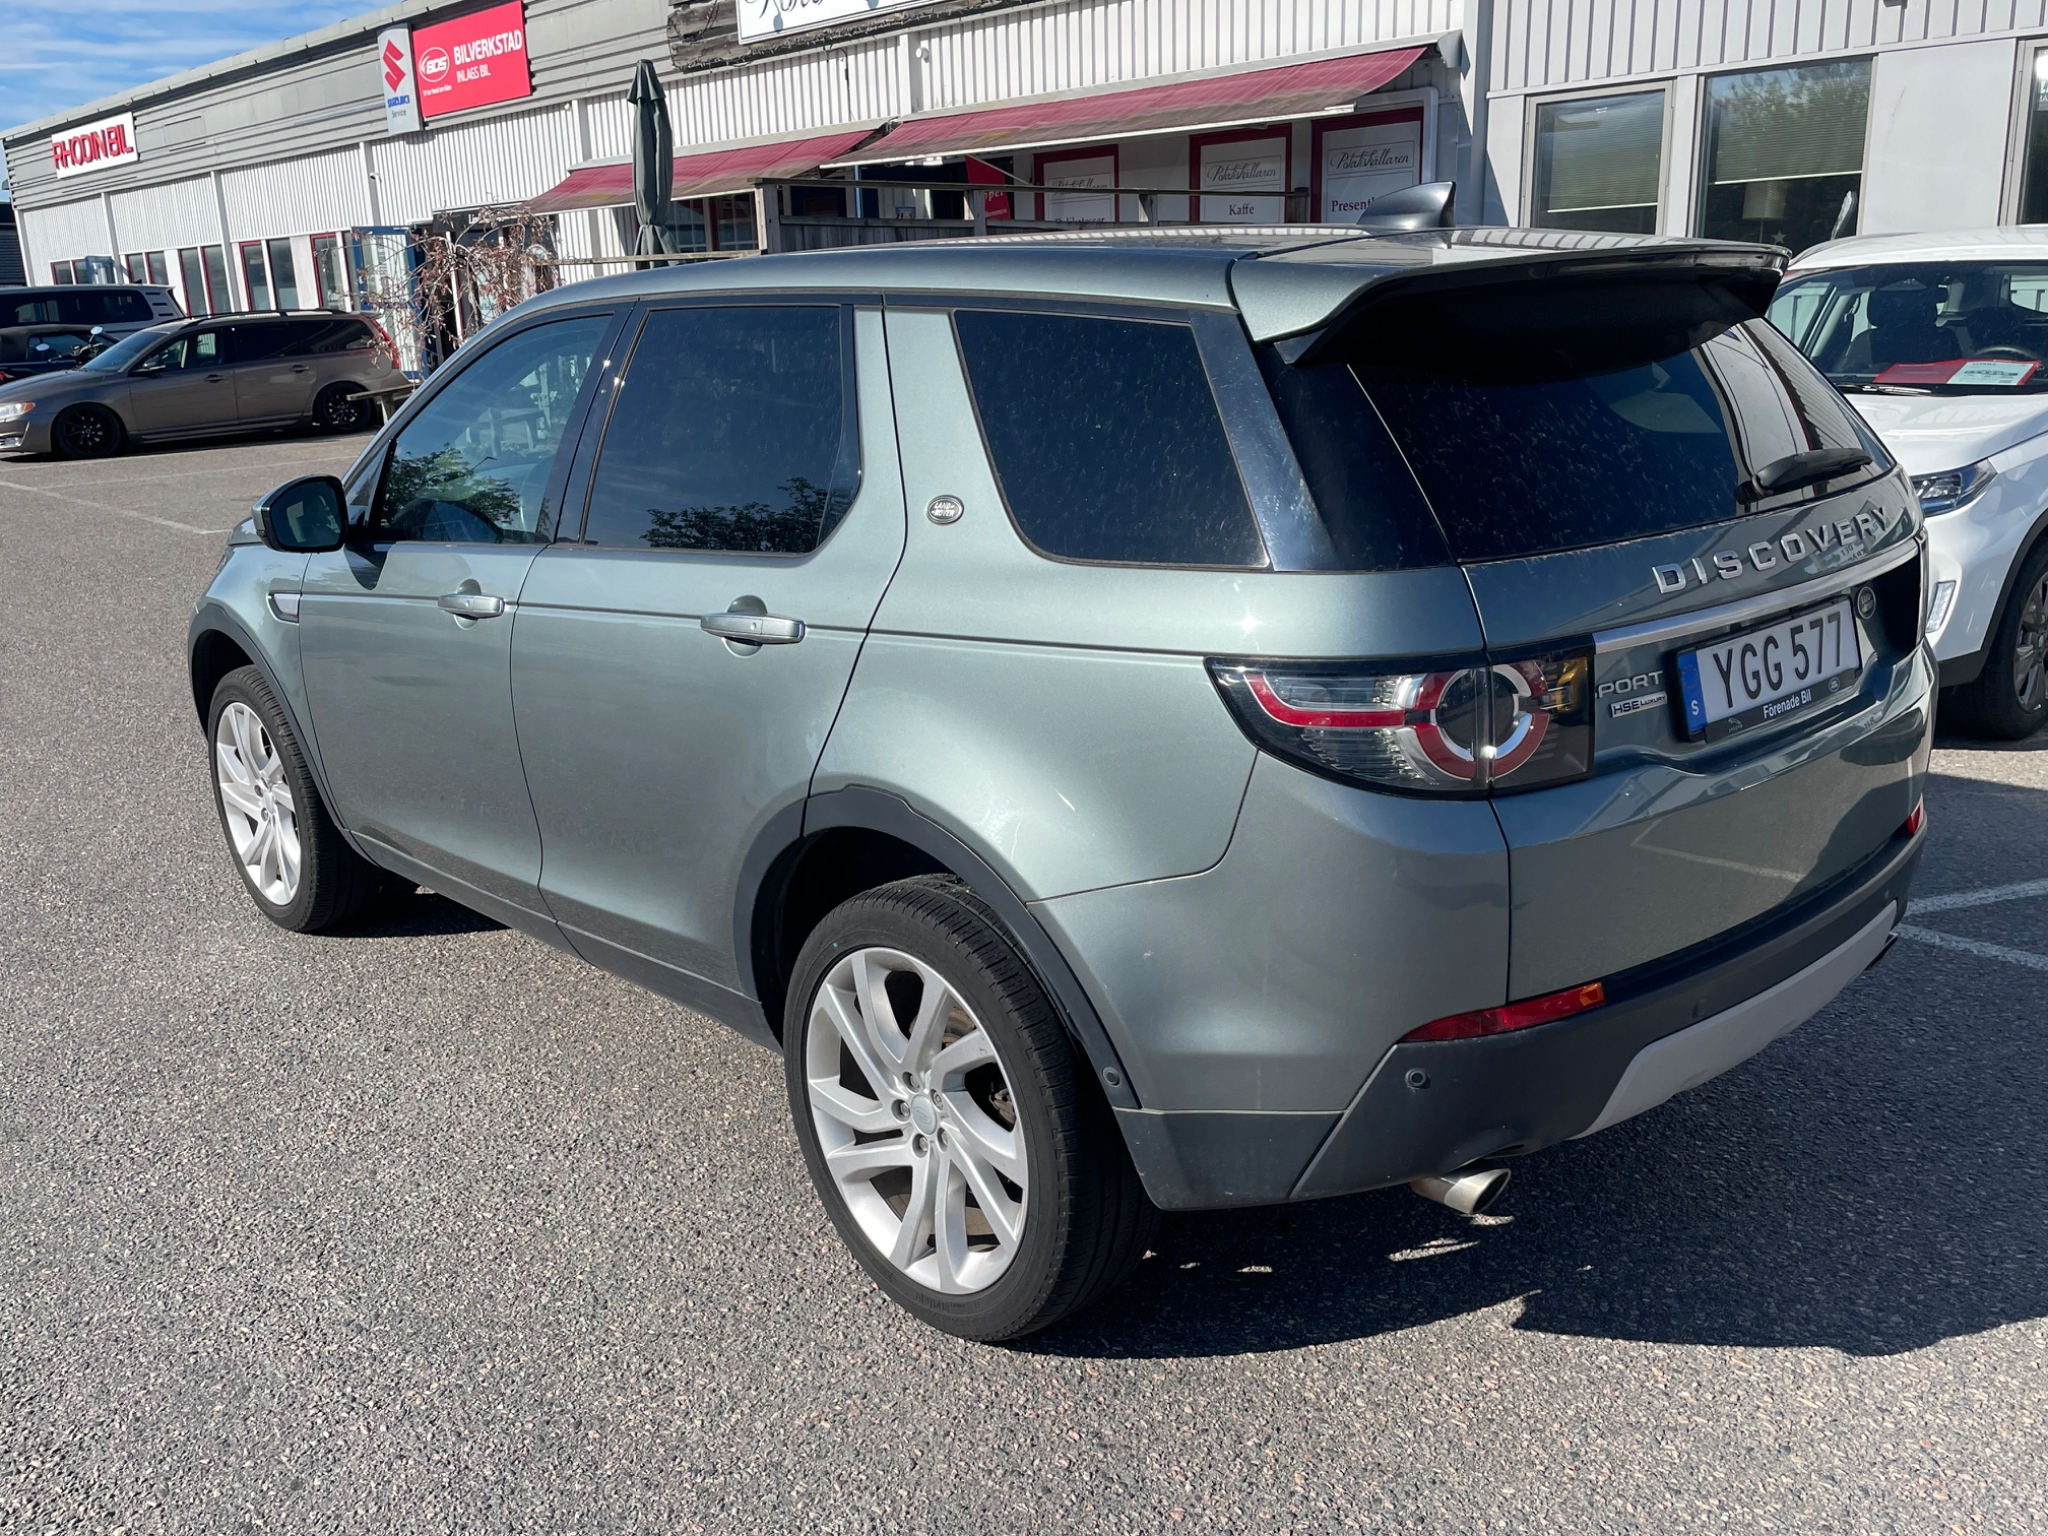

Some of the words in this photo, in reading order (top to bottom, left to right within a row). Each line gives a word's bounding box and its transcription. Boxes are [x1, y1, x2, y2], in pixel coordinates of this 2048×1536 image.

[453, 29, 523, 66] BILVERKSTAD
[456, 66, 479, 83] INLAGS
[480, 64, 491, 78] BIL
[52, 129, 108, 170] RHODIN
[106, 124, 134, 157] BIL
[1228, 203, 1255, 216] Kaffe
[1331, 197, 1374, 212] Present
[1652, 506, 1887, 594] DISCOVERY
[1712, 635, 1783, 709] YGG
[1790, 612, 1841, 680] 577
[1613, 700, 1640, 715] HSE
[1691, 700, 1699, 716] S
[1763, 696, 1799, 719] Förenade
[1800, 690, 1811, 704] Bil
